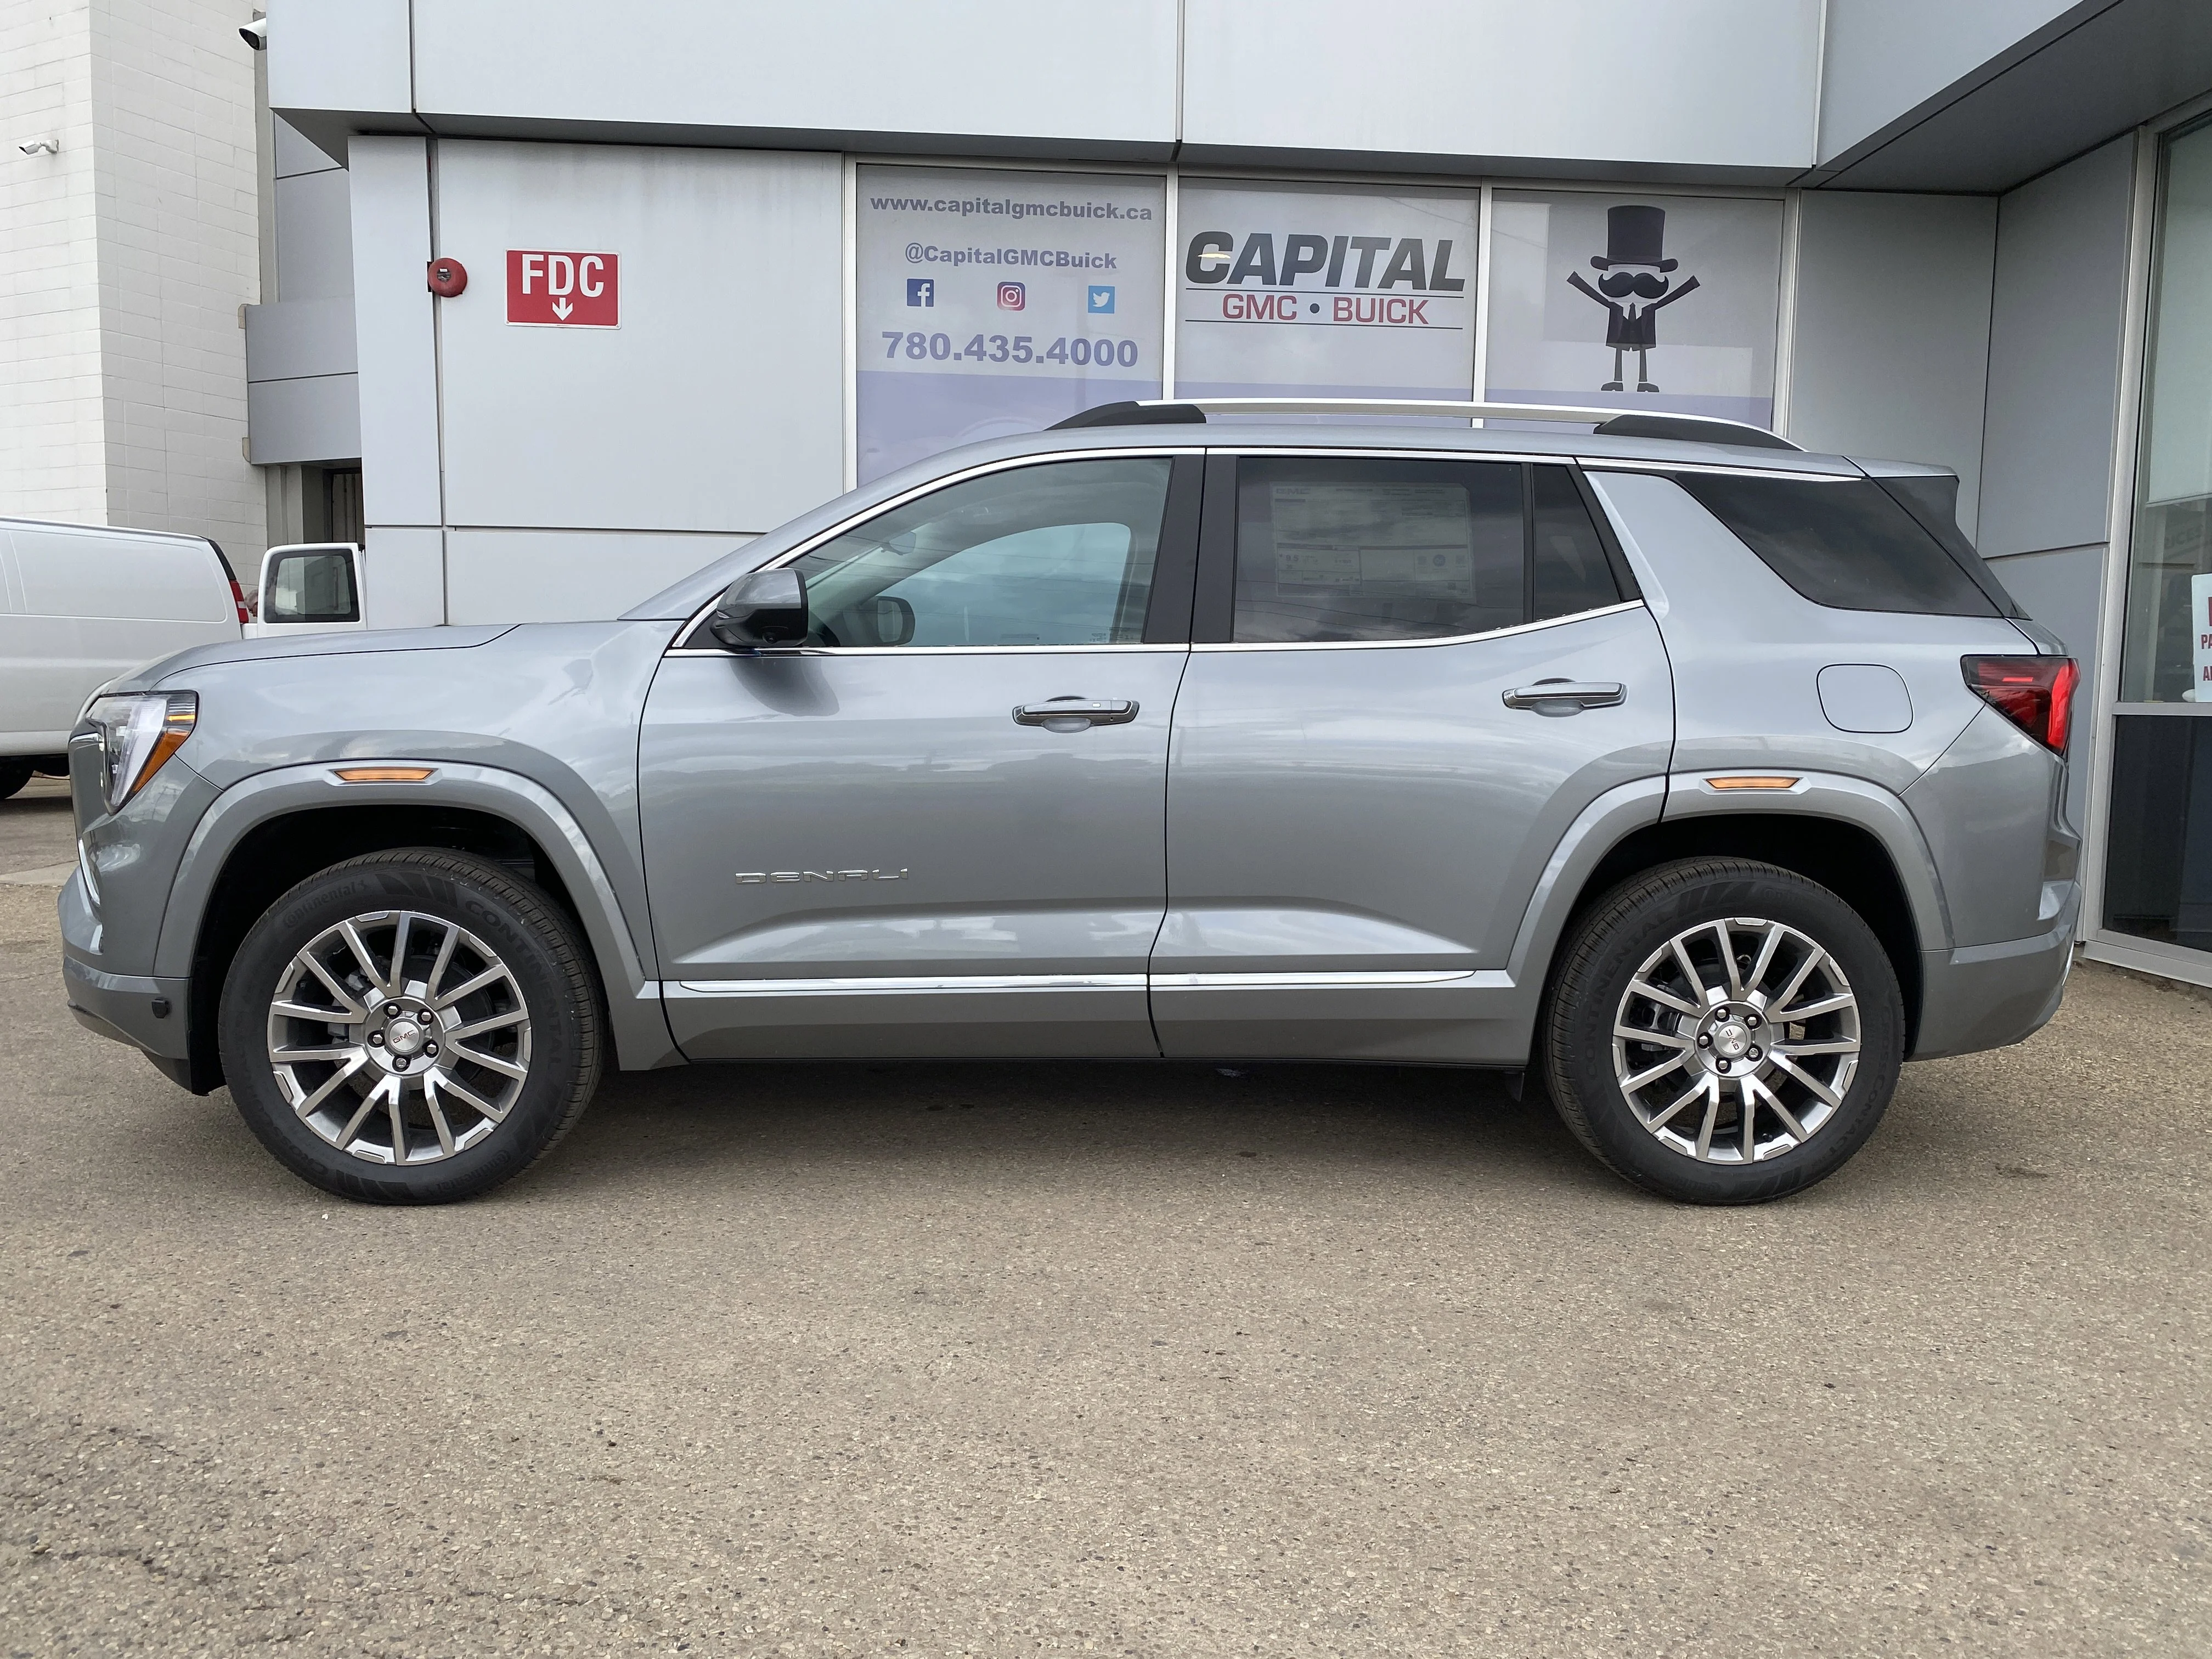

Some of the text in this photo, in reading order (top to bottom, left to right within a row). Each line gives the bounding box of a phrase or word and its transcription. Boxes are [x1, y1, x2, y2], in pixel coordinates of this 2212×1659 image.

[871, 197, 1152, 220] www.capitalgmcbuick.ca
[905, 242, 1117, 269] @CapitalGMCBuick
[1186, 231, 1465, 291] CAPITAL
[522, 253, 605, 297] FDC
[1222, 294, 1429, 324] GMC BUICK
[882, 331, 1138, 367] 780.435.4000
[735, 868, 909, 884] DENALI
[465, 899, 565, 1065] CONTINENTAL
[392, 1029, 416, 1044] GMC
[1725, 1029, 1740, 1050] GMC
